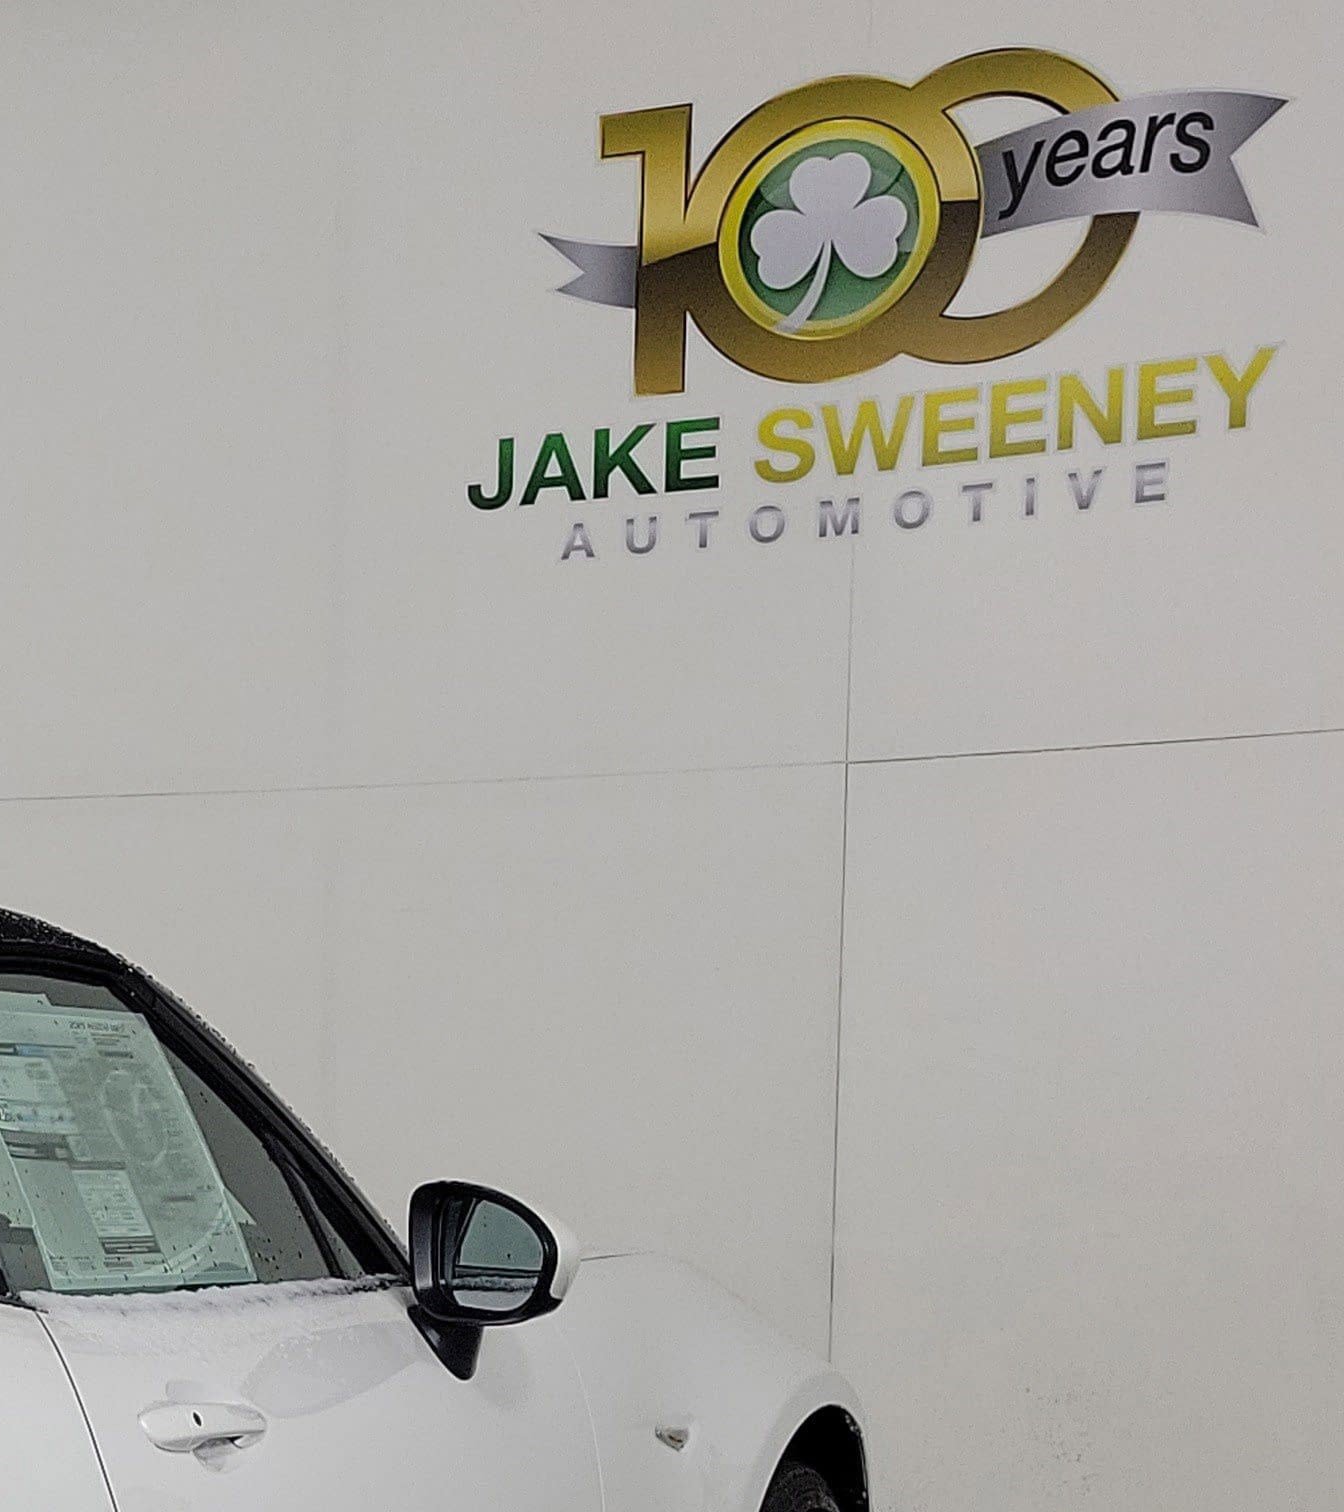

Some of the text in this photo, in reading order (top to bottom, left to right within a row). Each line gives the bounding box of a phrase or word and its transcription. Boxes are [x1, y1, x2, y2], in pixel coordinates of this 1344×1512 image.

[600, 47, 1214, 396] 100 years
[468, 347, 1277, 510] JAKE SWEENEY
[561, 462, 1168, 562] AUTOMOTIVE
